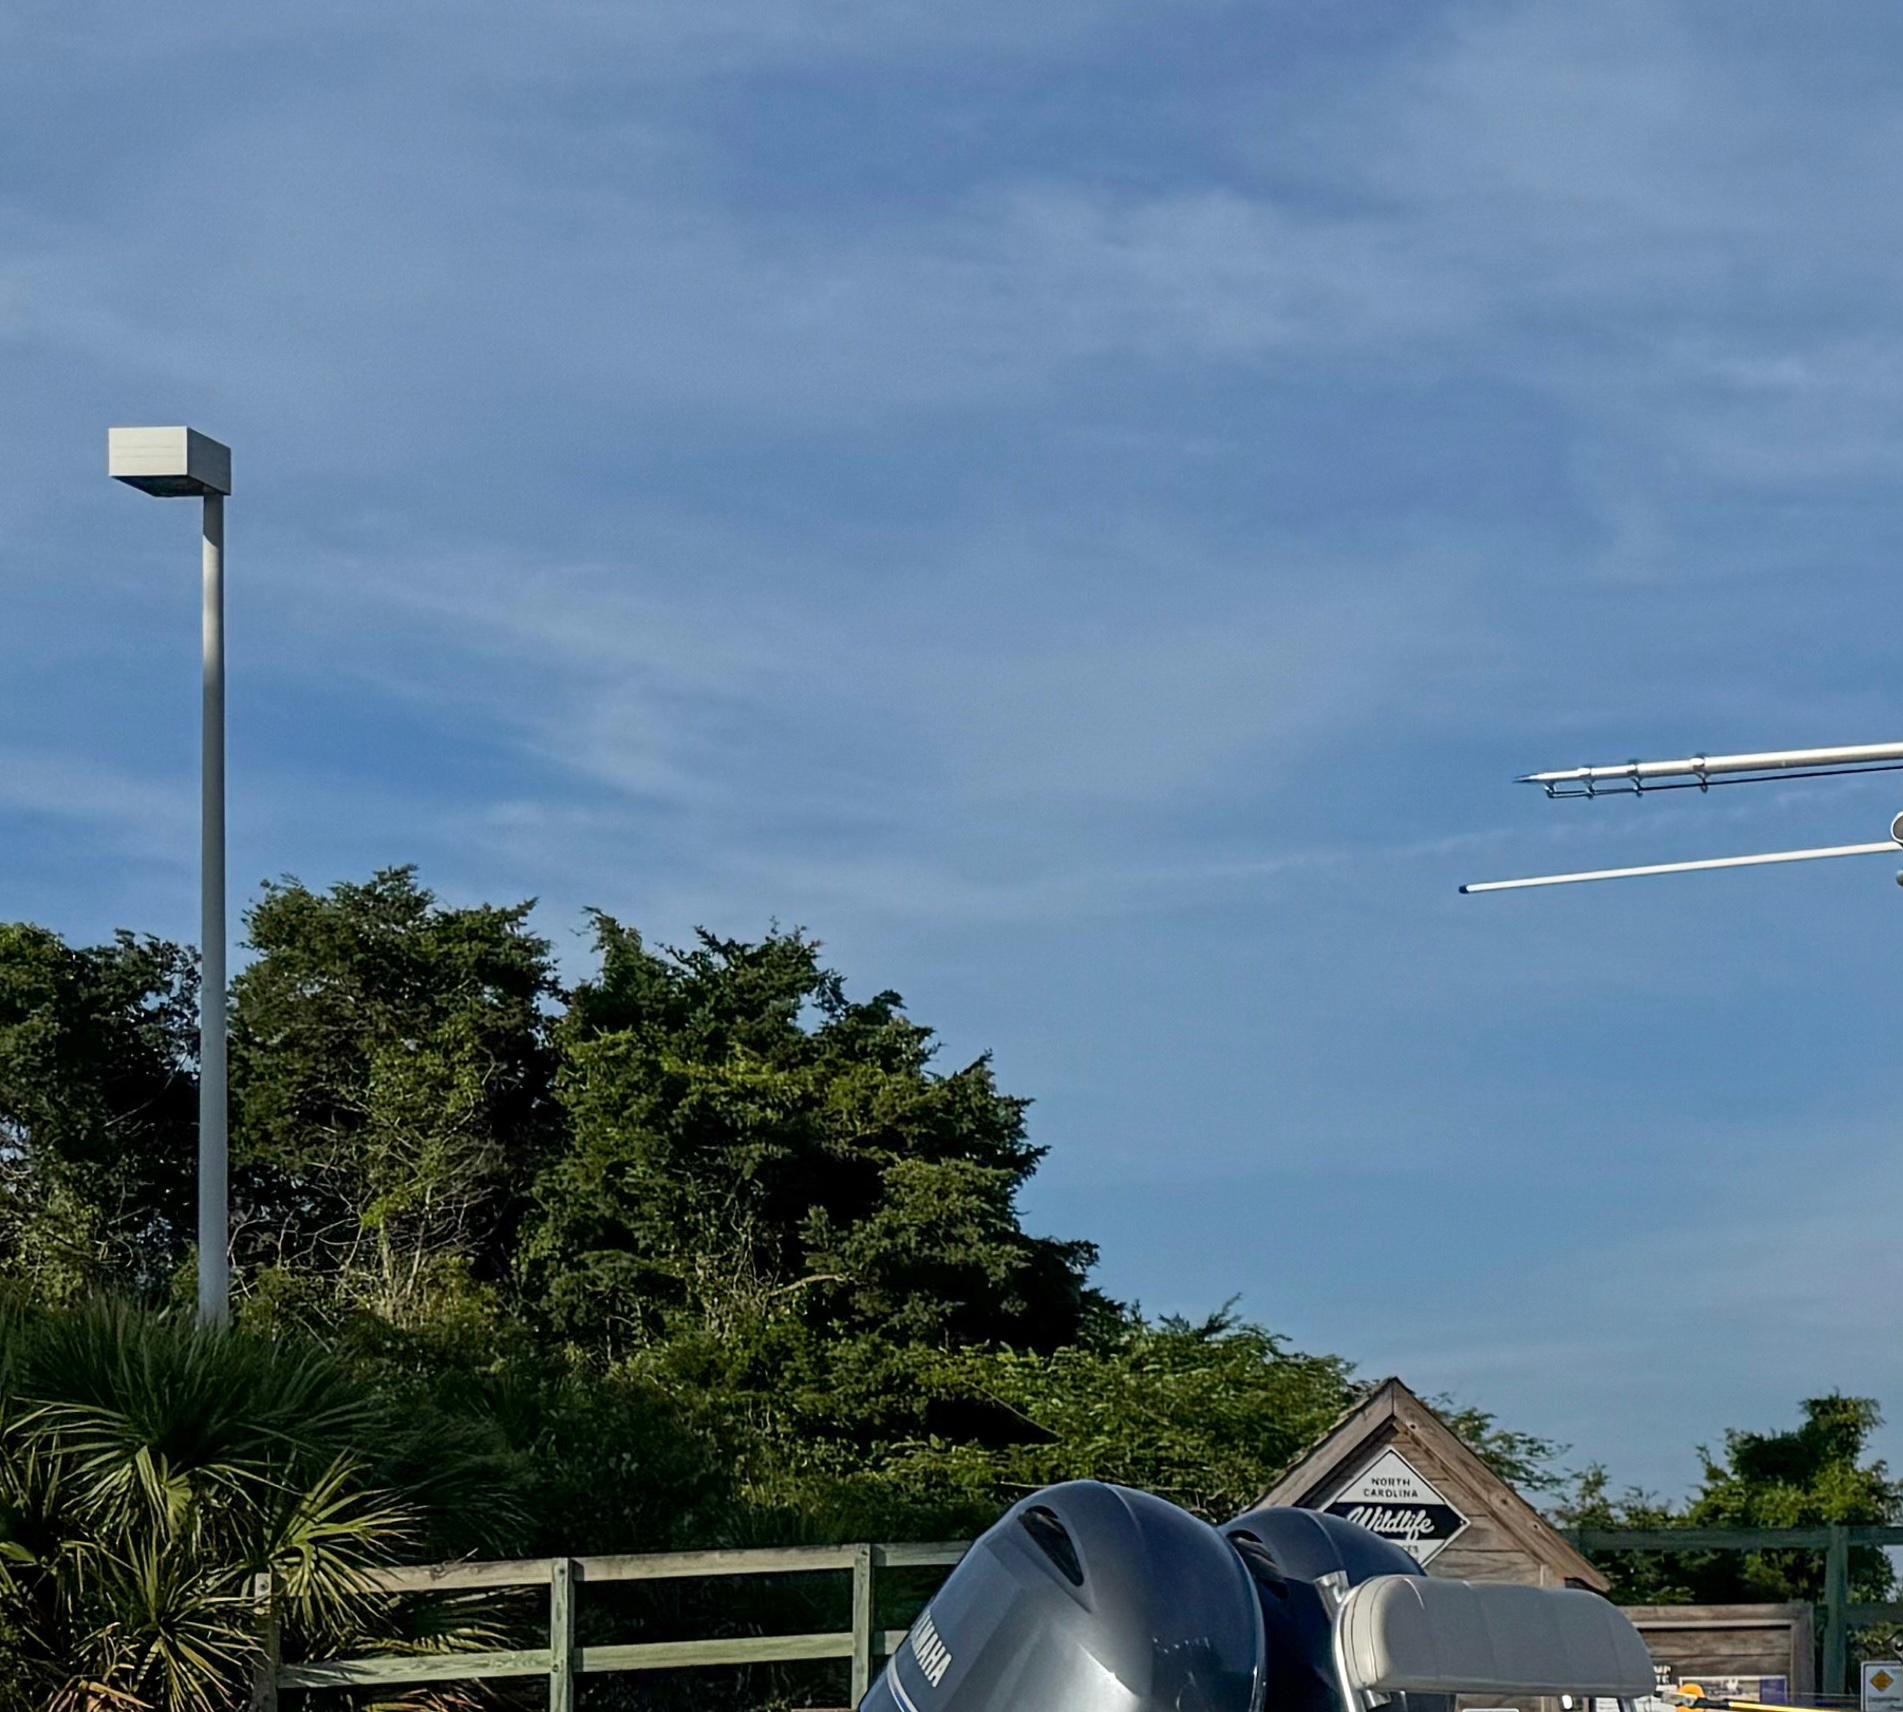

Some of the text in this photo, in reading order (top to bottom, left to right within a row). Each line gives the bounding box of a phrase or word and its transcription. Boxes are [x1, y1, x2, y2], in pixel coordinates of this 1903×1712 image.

[1371, 1477, 1410, 1486] NORTH
[1363, 1488, 1418, 1498] CAROLINA
[1347, 1506, 1435, 1541] Wildlife
